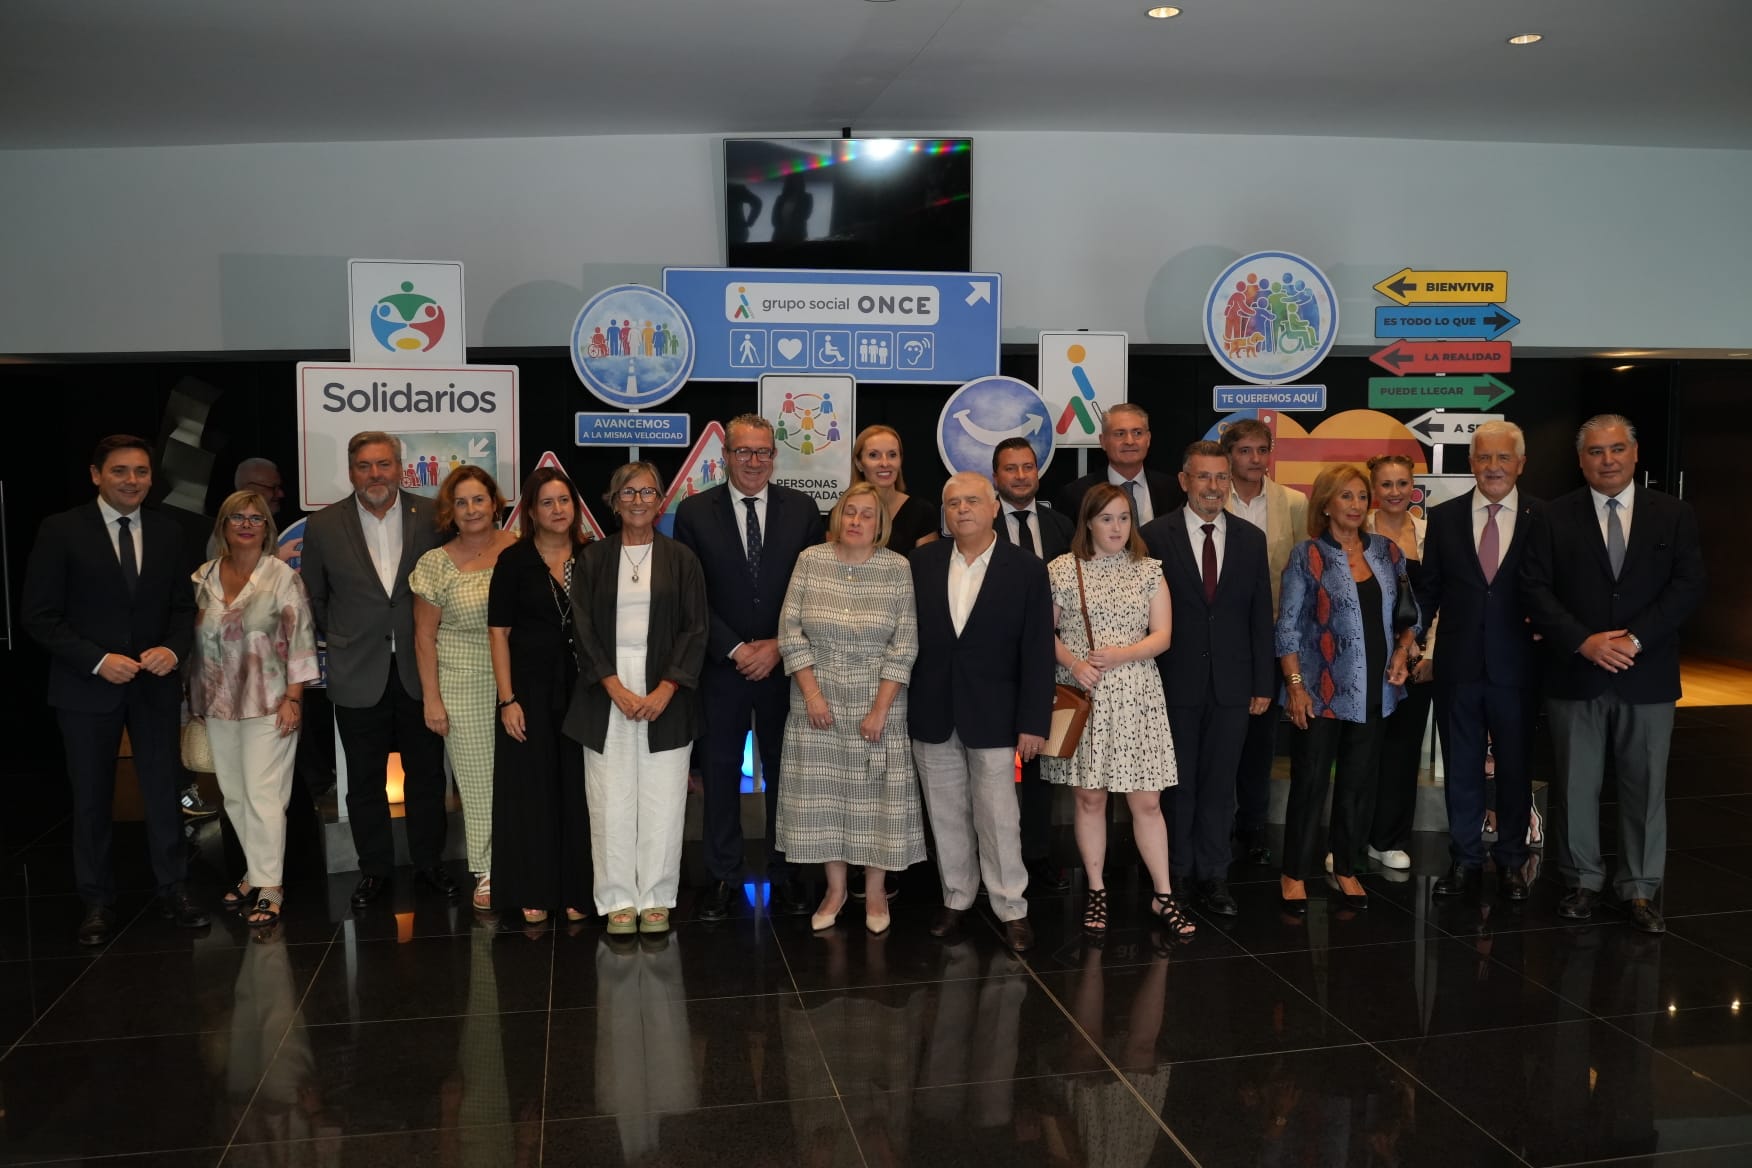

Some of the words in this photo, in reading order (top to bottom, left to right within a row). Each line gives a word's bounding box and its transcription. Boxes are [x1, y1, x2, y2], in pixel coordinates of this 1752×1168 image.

[1426, 282, 1495, 292] BIENVIVIR
[762, 298, 806, 312] grupo
[809, 297, 850, 310] social
[857, 295, 931, 315] ONCE
[1383, 317, 1397, 326] ES
[1400, 317, 1432, 326] TODO
[1435, 317, 1450, 326] LO
[1453, 317, 1477, 327] QUE
[1424, 353, 1439, 361] LA
[1442, 352, 1502, 361] REALIDAD
[1380, 387, 1418, 396] PUEDE
[1420, 387, 1464, 396] LLEGAR
[322, 381, 497, 414] Solidarios
[1221, 394, 1234, 403] TE
[1235, 393, 1292, 404] QUEREMOS
[1293, 391, 1318, 404] AQUÍ
[593, 418, 671, 429] AVANCEMOS
[1453, 423, 1464, 433] A
[583, 431, 590, 439] A
[591, 431, 602, 439] LA
[603, 431, 633, 439] MISMA
[634, 432, 683, 440] VELOCIDAD
[776, 479, 838, 489] PERSONAS
